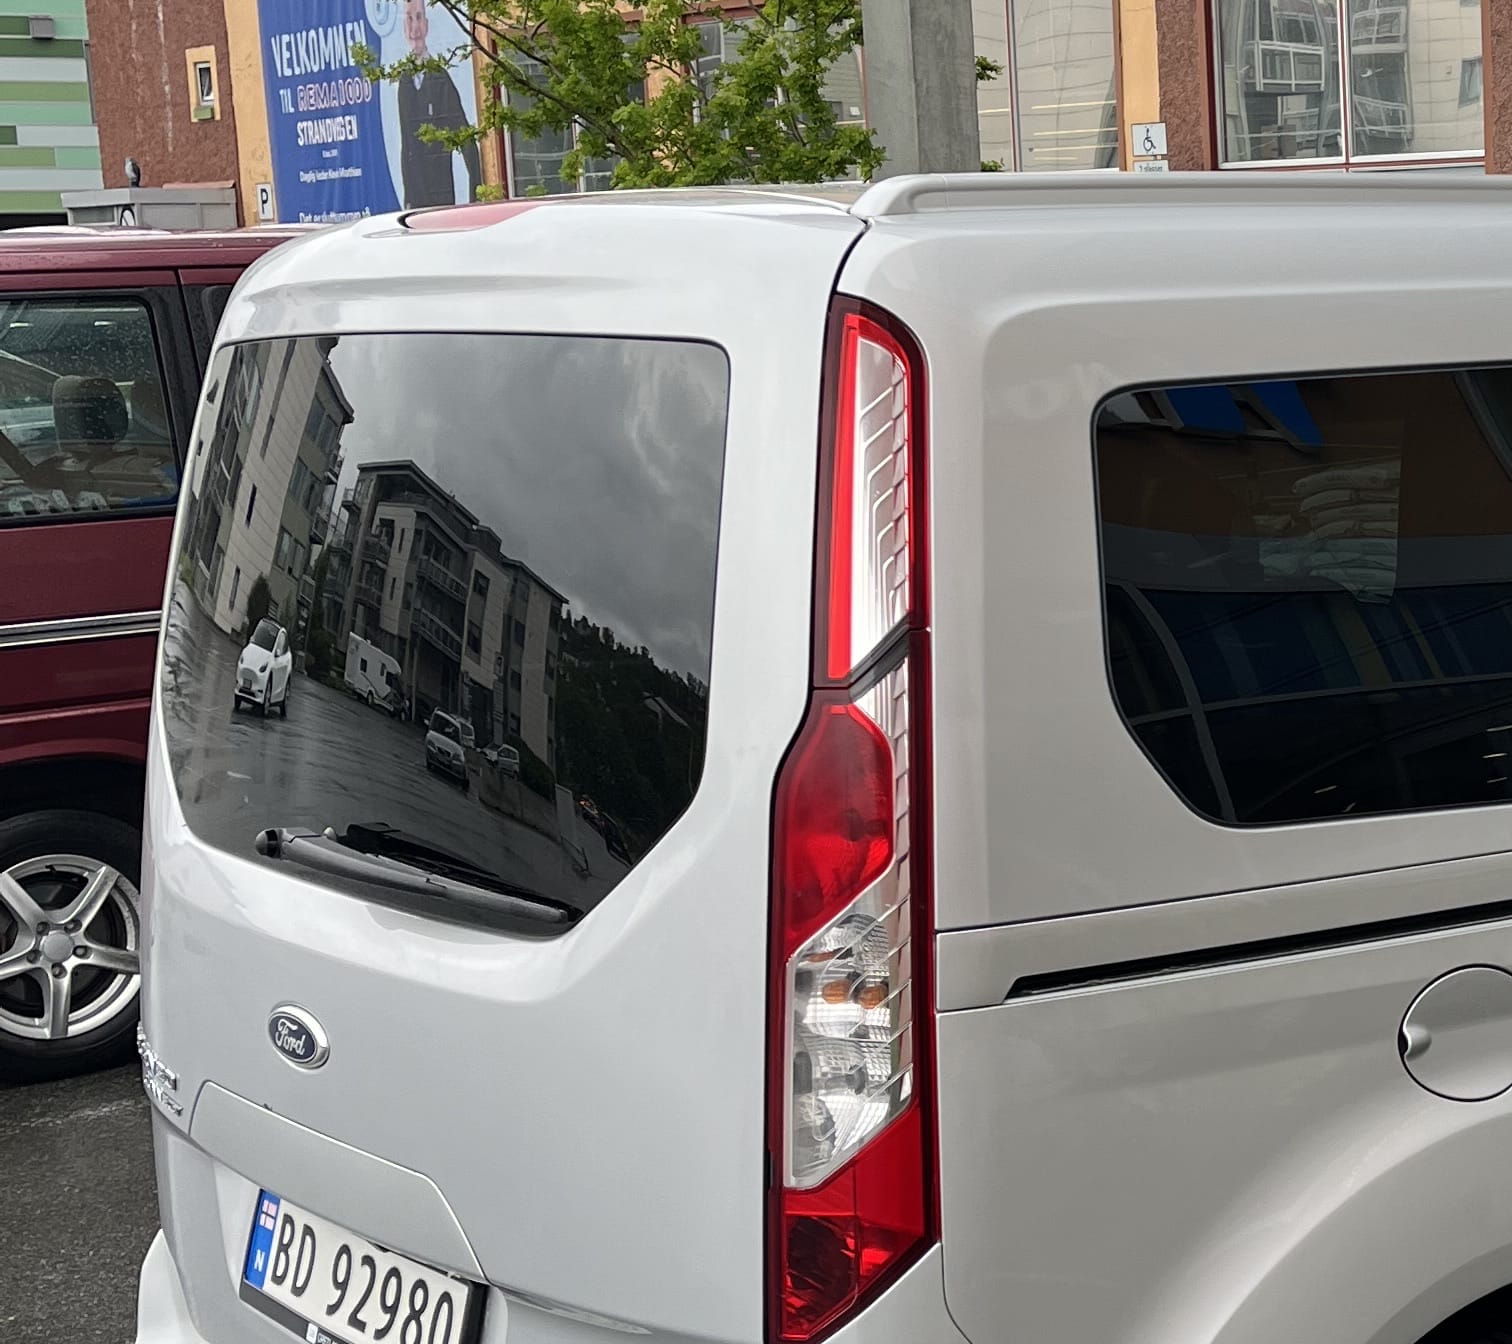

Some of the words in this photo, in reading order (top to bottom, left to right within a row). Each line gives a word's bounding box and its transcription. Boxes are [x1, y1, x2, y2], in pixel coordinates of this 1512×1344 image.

[271, 19, 368, 78] VELKOMMEN
[279, 87, 295, 114] TIL
[260, 189, 268, 214] P
[275, 1019, 306, 1056] Ford
[254, 1249, 266, 1272] N
[271, 1213, 317, 1297] BD
